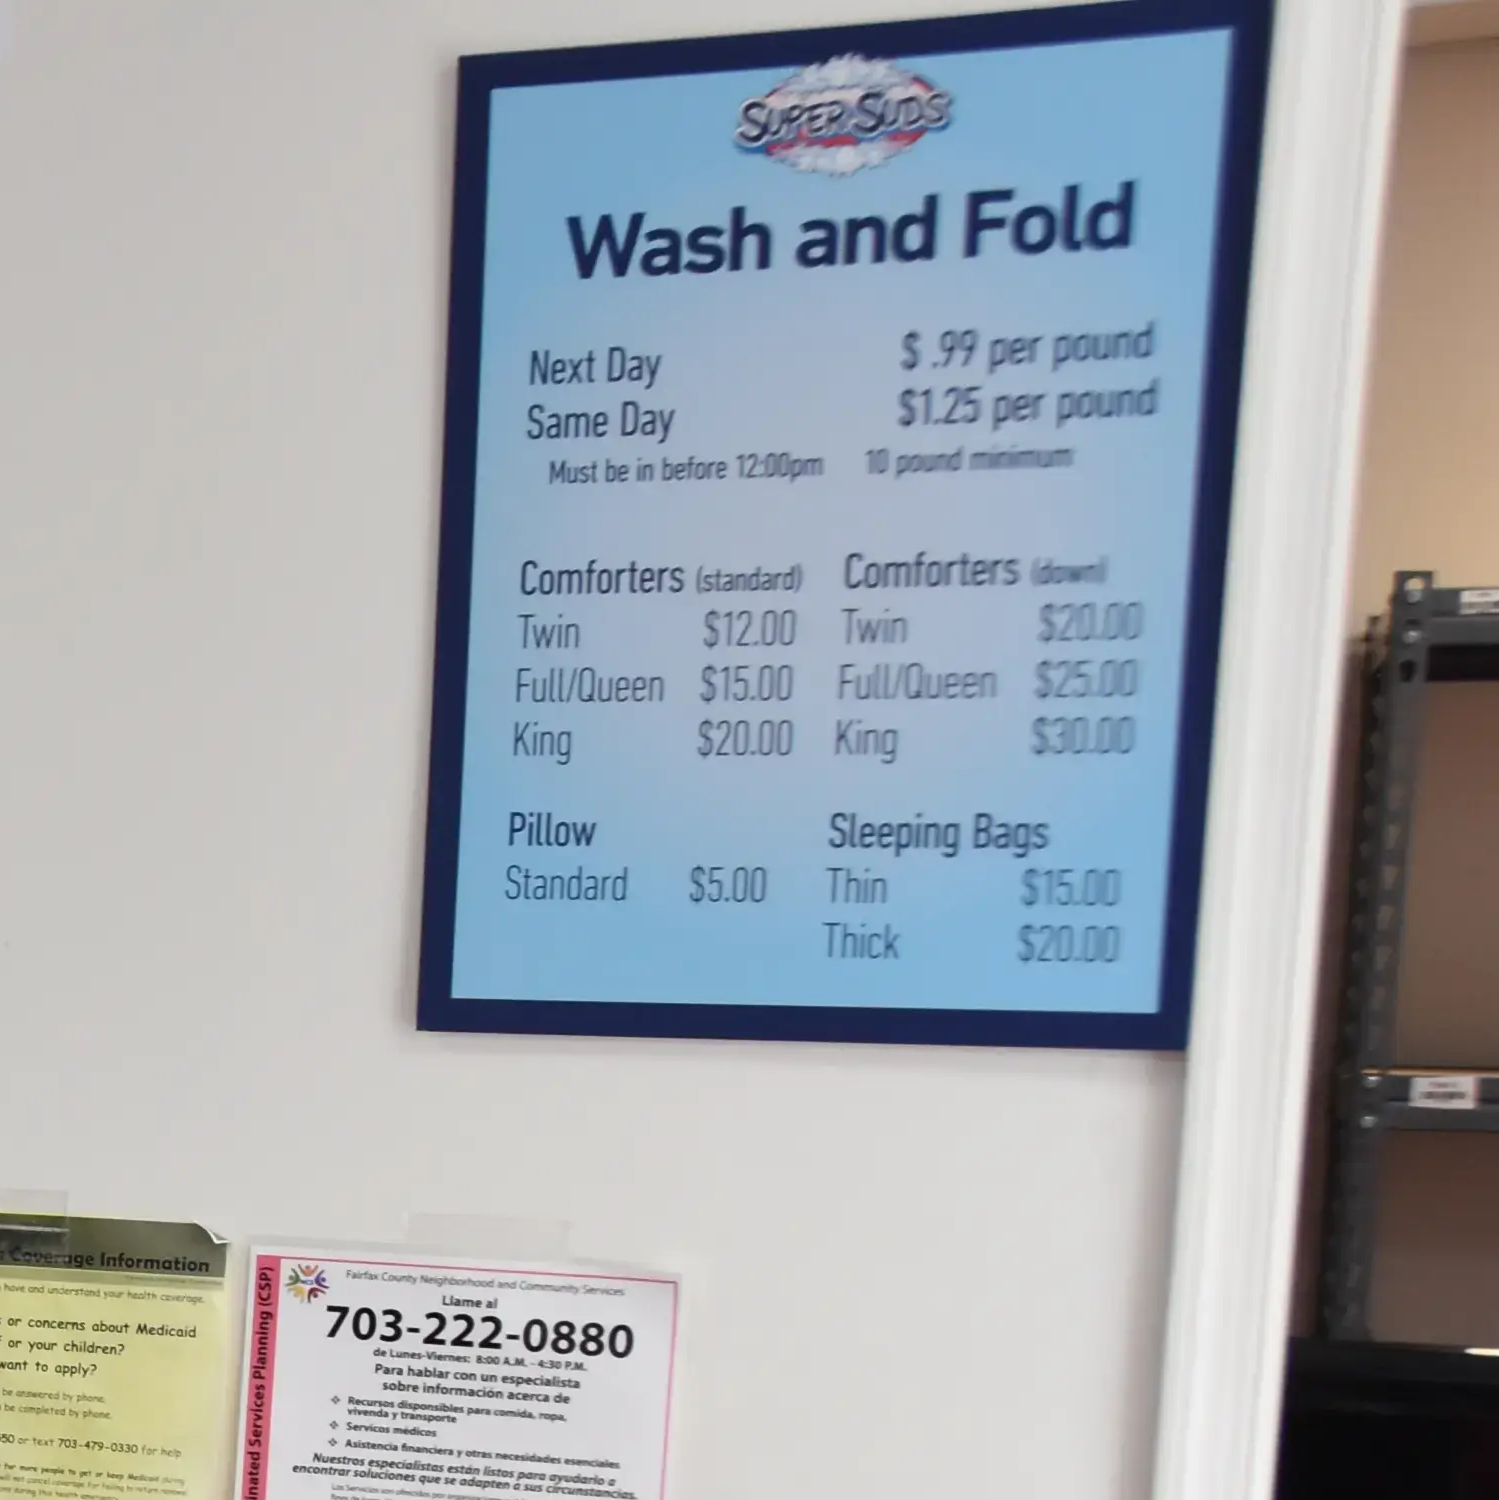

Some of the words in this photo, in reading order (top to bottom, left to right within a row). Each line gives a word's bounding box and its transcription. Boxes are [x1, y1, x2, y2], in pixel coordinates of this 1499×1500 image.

[567, 206, 772, 280] Wash
[795, 196, 937, 269] and
[963, 180, 1136, 258] Fold
[529, 350, 596, 386] Next
[607, 347, 663, 390] Day
[900, 331, 922, 372] $
[930, 328, 979, 369] .99
[989, 333, 1045, 375] per
[1052, 321, 1156, 371] pound
[526, 404, 609, 441] Same
[619, 403, 675, 445] Day
[897, 388, 981, 430] $1.25
[991, 389, 1047, 433] per
[1056, 380, 1159, 428] pound
[548, 458, 598, 485] Must
[605, 457, 629, 483] be
[636, 457, 654, 482] in
[661, 455, 728, 482] before
[736, 451, 824, 486] 12:00pm
[865, 448, 890, 475] 10
[896, 447, 963, 476] pound
[969, 443, 1074, 471] minimum
[519, 560, 686, 598] Comforters
[694, 564, 804, 597] (standard)
[843, 552, 1021, 592] Comforters
[518, 613, 581, 650] Twin
[702, 608, 797, 649] $12.00
[840, 608, 908, 648] Twin
[1037, 601, 1145, 644] $20.00
[515, 667, 666, 707] Full/Queen
[699, 663, 794, 706] $15.00
[837, 663, 998, 704] Full/Queen
[1032, 658, 1139, 702] $25.00
[512, 721, 573, 767] King
[696, 719, 794, 760] $20.00
[834, 718, 900, 765] King
[1029, 715, 1136, 759] $30.00
[507, 811, 597, 849] Pillow
[828, 813, 962, 859] Sleeping
[972, 814, 1050, 860] Bags
[505, 865, 629, 905] Standard
[688, 865, 769, 907] $5.00
[827, 868, 889, 906] Thin
[1019, 867, 1122, 910] $15.00
[822, 922, 901, 962] Thick
[1016, 923, 1121, 967] $20.00
[100, 1251, 211, 1274] Information
[345, 1269, 380, 1281] Fairfax
[381, 1272, 418, 1285] County
[419, 1275, 495, 1290] Neighborhood
[497, 1279, 517, 1290] and
[519, 1281, 580, 1296] Community
[582, 1285, 626, 1296] Services
[257, 1265, 275, 1307] (CSP)
[441, 1294, 483, 1308] Llame
[485, 1298, 499, 1309] al
[7, 1316, 23, 1328] or
[27, 1317, 86, 1332] concerns
[91, 1320, 131, 1334] about
[135, 1322, 198, 1339] Medicaid
[7, 1338, 23, 1349] or
[27, 1340, 58, 1354] your
[63, 1340, 125, 1357] children?
[252, 1310, 274, 1382] Planning
[326, 1304, 635, 1359] 703-222-0880
[35, 1360, 50, 1373] to
[54, 1362, 98, 1379] apply?
[374, 1363, 404, 1377] Para
[407, 1365, 451, 1381] hablar
[453, 1371, 478, 1382] con
[480, 1373, 498, 1383] un
[500, 1374, 582, 1390] especialista
[382, 1380, 420, 1394] sobre
[506, 1392, 551, 1404] acerca
[553, 1392, 572, 1404] de
[248, 1382, 266, 1449] Services
[17, 1436, 29, 1445] or
[32, 1437, 55, 1447] text
[57, 1438, 139, 1454] 703-479-0330
[141, 1445, 158, 1456] for
[160, 1447, 182, 1459] help
